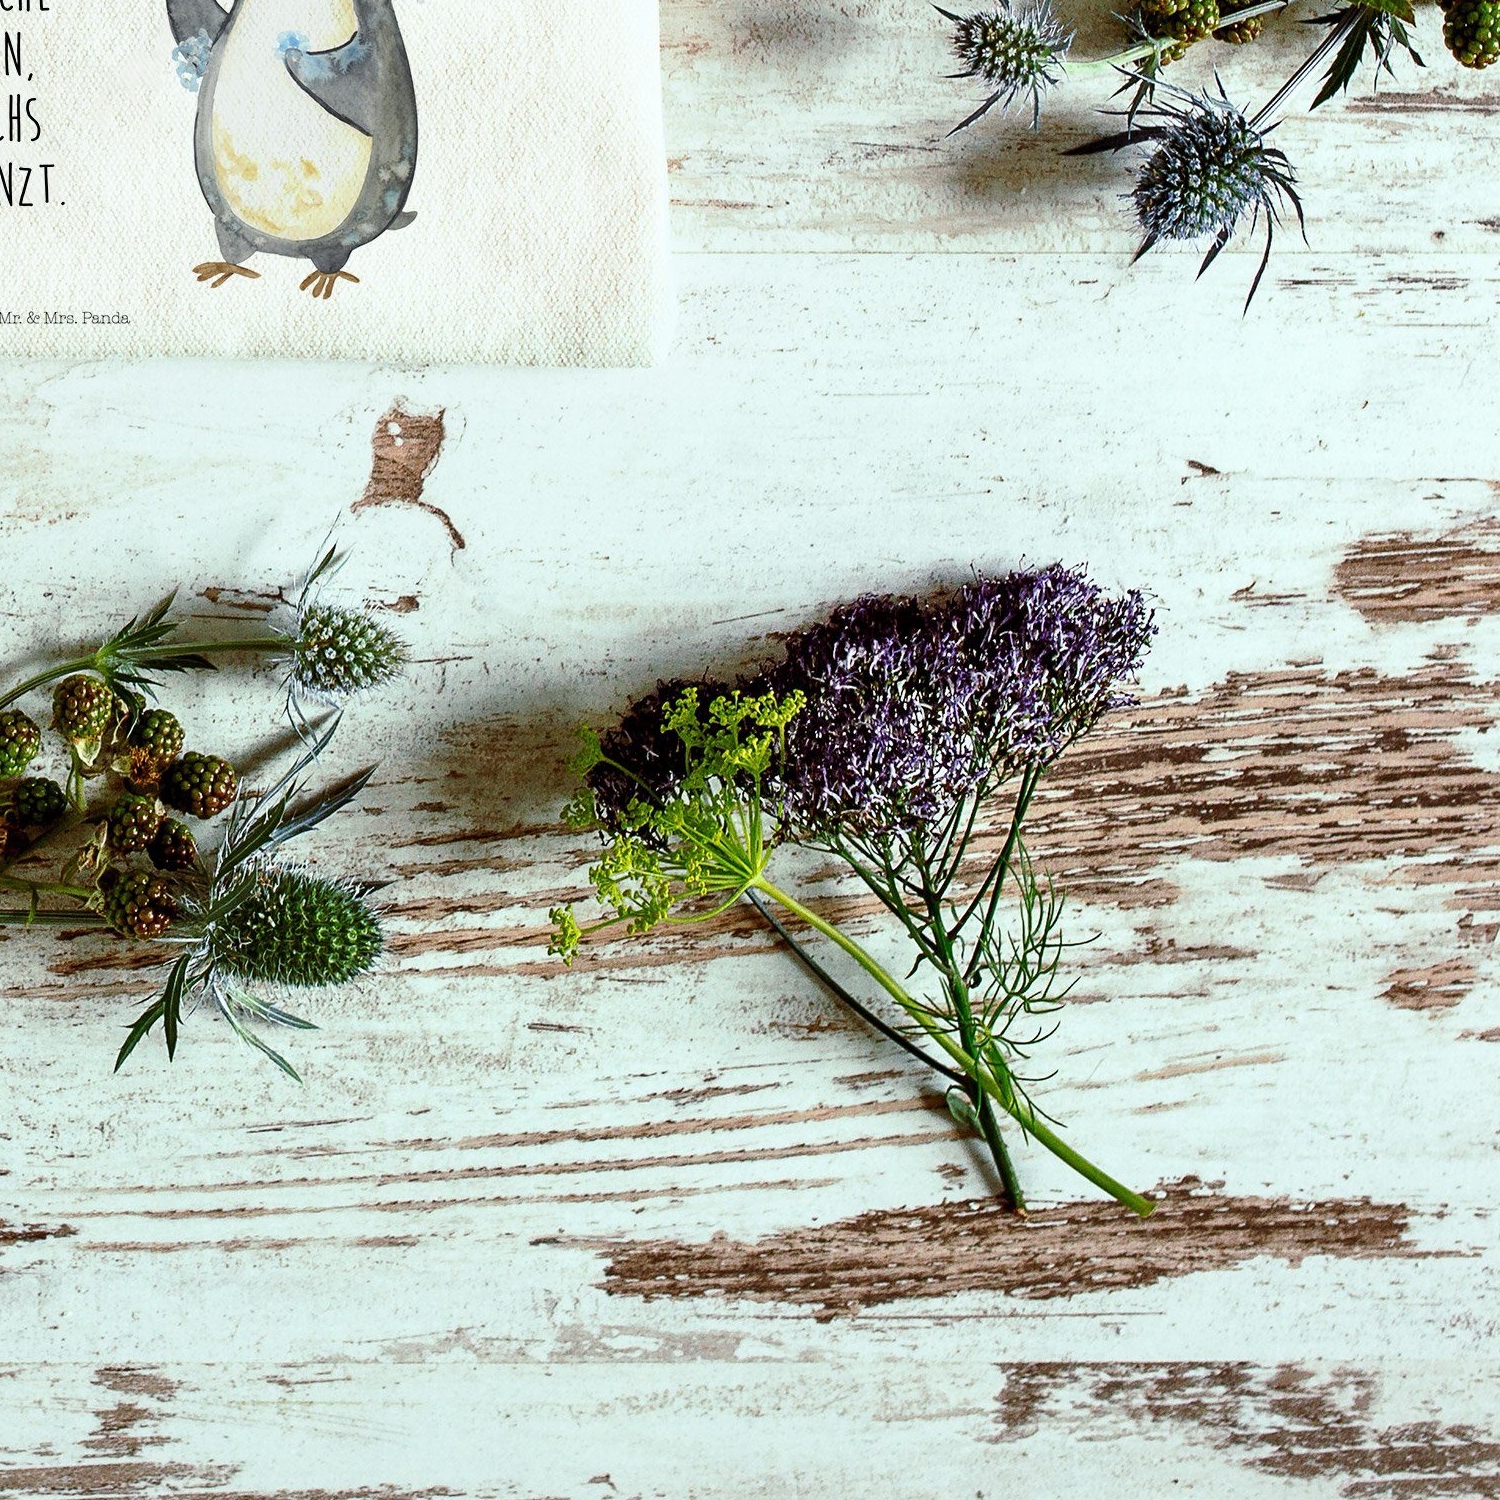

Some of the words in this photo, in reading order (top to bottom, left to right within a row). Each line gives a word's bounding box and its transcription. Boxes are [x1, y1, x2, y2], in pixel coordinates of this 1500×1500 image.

[26, 311, 40, 325] &
[43, 311, 78, 325] Mrs.
[82, 311, 131, 325] Panda
